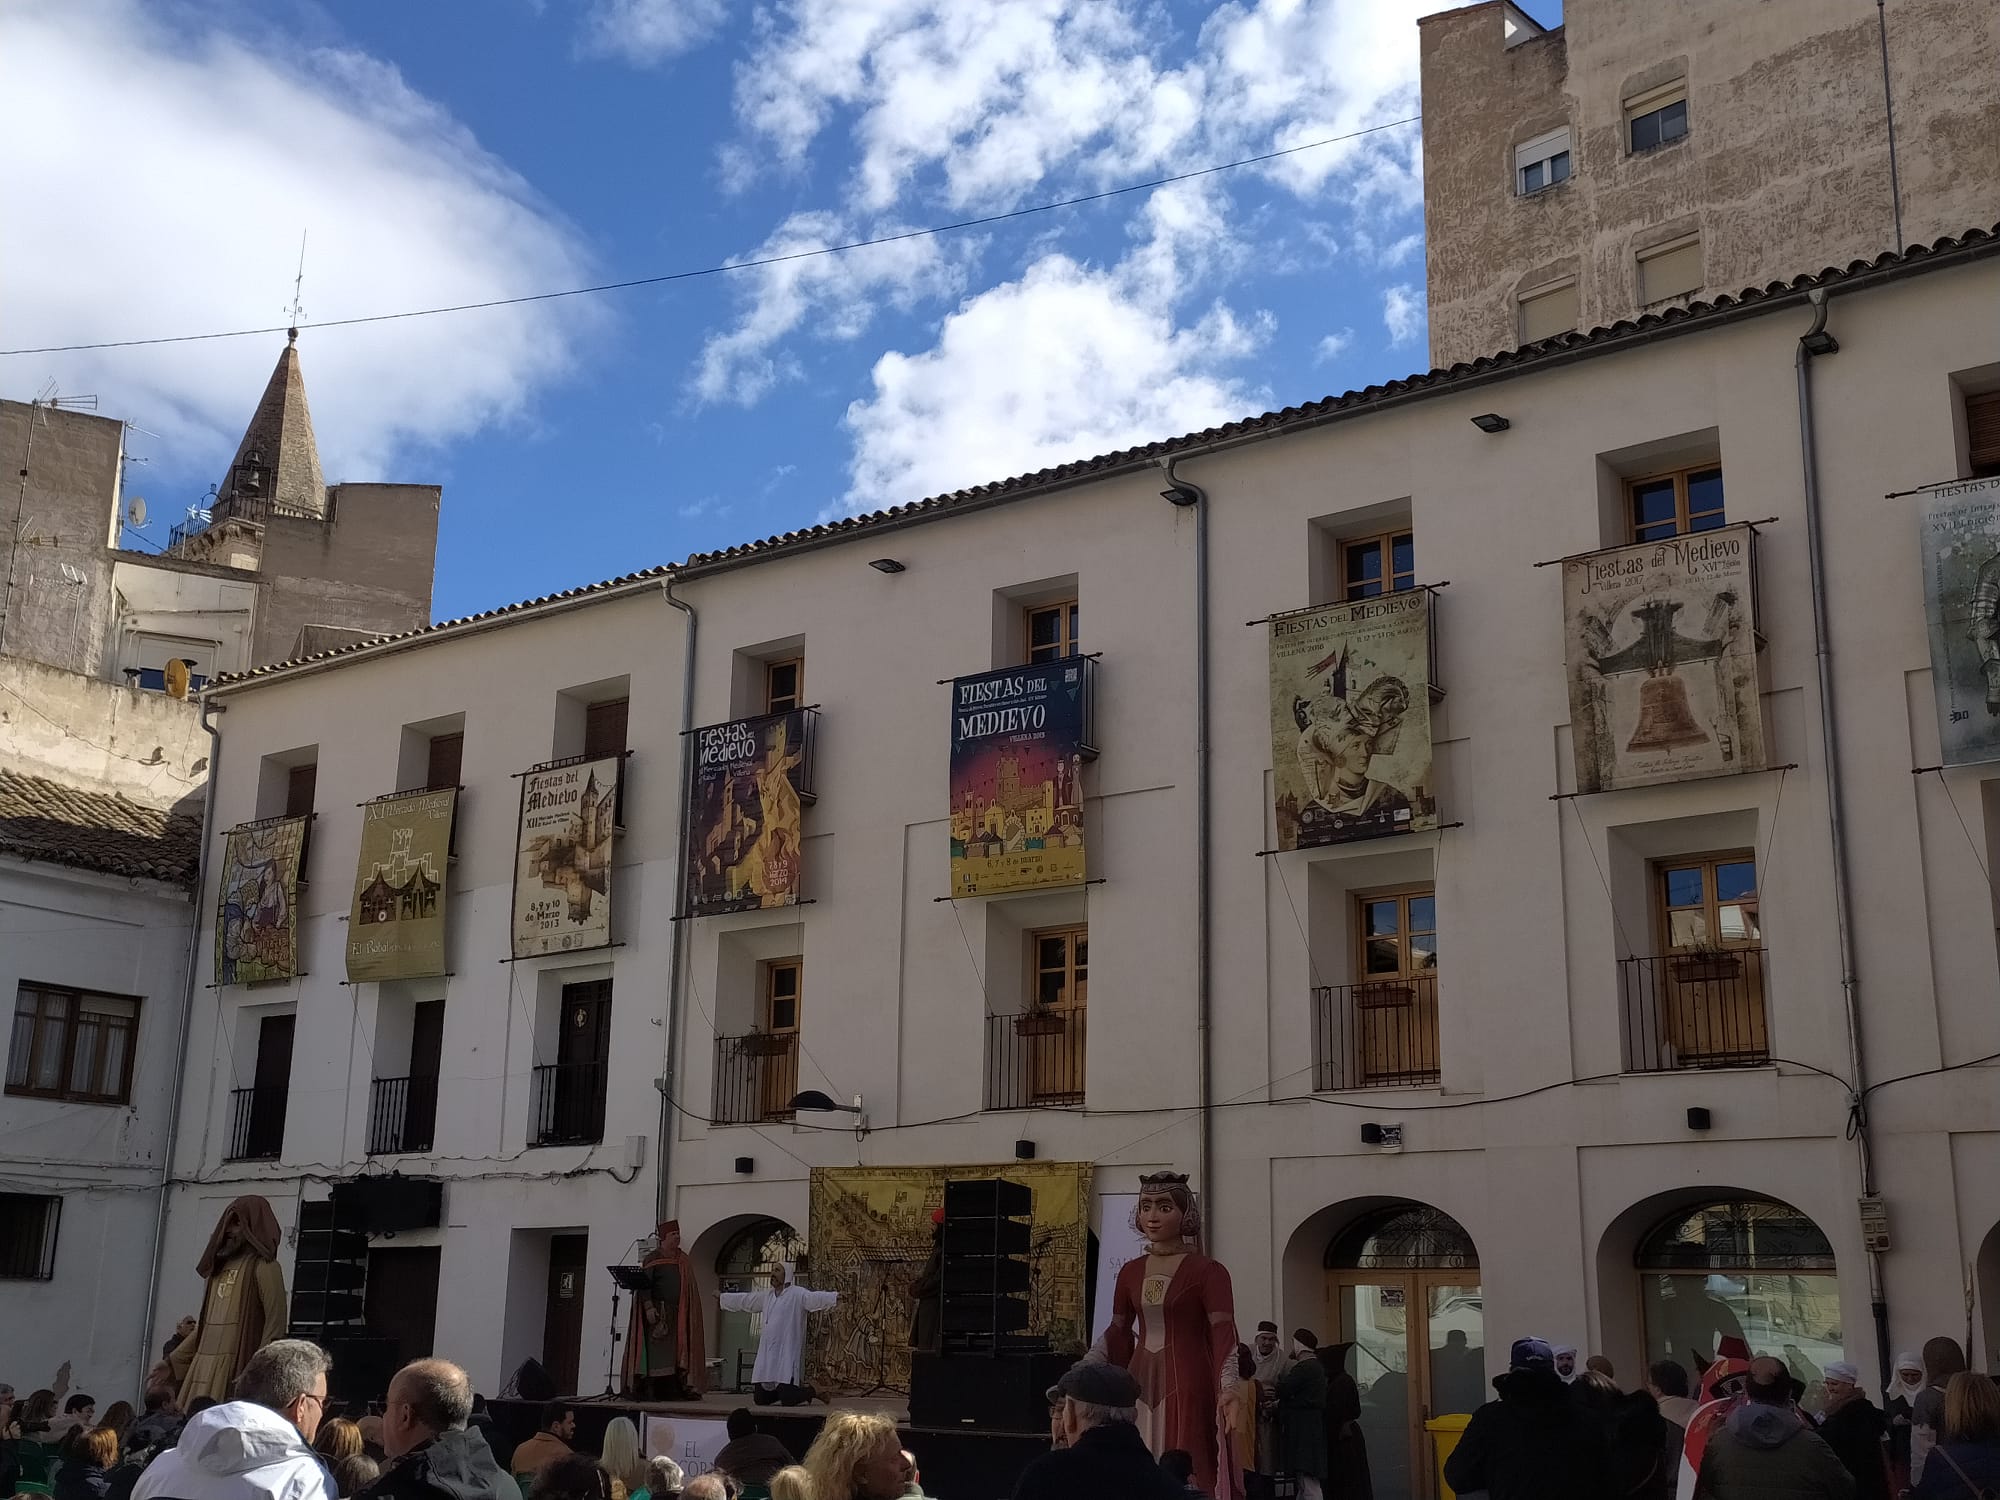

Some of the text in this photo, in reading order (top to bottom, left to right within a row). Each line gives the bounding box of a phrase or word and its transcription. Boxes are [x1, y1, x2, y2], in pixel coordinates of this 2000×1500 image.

[1934, 481, 1986, 499] FIESTAS
[1576, 538, 1740, 594] Fiestas del Medievo
[1624, 575, 1644, 587] 2017
[1274, 615, 1328, 637] FIESTAS
[1330, 613, 1348, 624] DEL
[1350, 596, 1420, 622] MEDIEVO
[1276, 647, 1306, 658] VILLENA
[959, 675, 1024, 704] FIESTAS
[1026, 678, 1047, 694] DEL
[958, 704, 1046, 741] MEDIEVO
[527, 770, 578, 794] Fiestas del
[525, 788, 578, 813] Medievo
[552, 899, 561, 908] 10
[525, 911, 560, 922] de Marzo
[540, 919, 559, 930] 2013
[685, 1440, 700, 1458] EL
